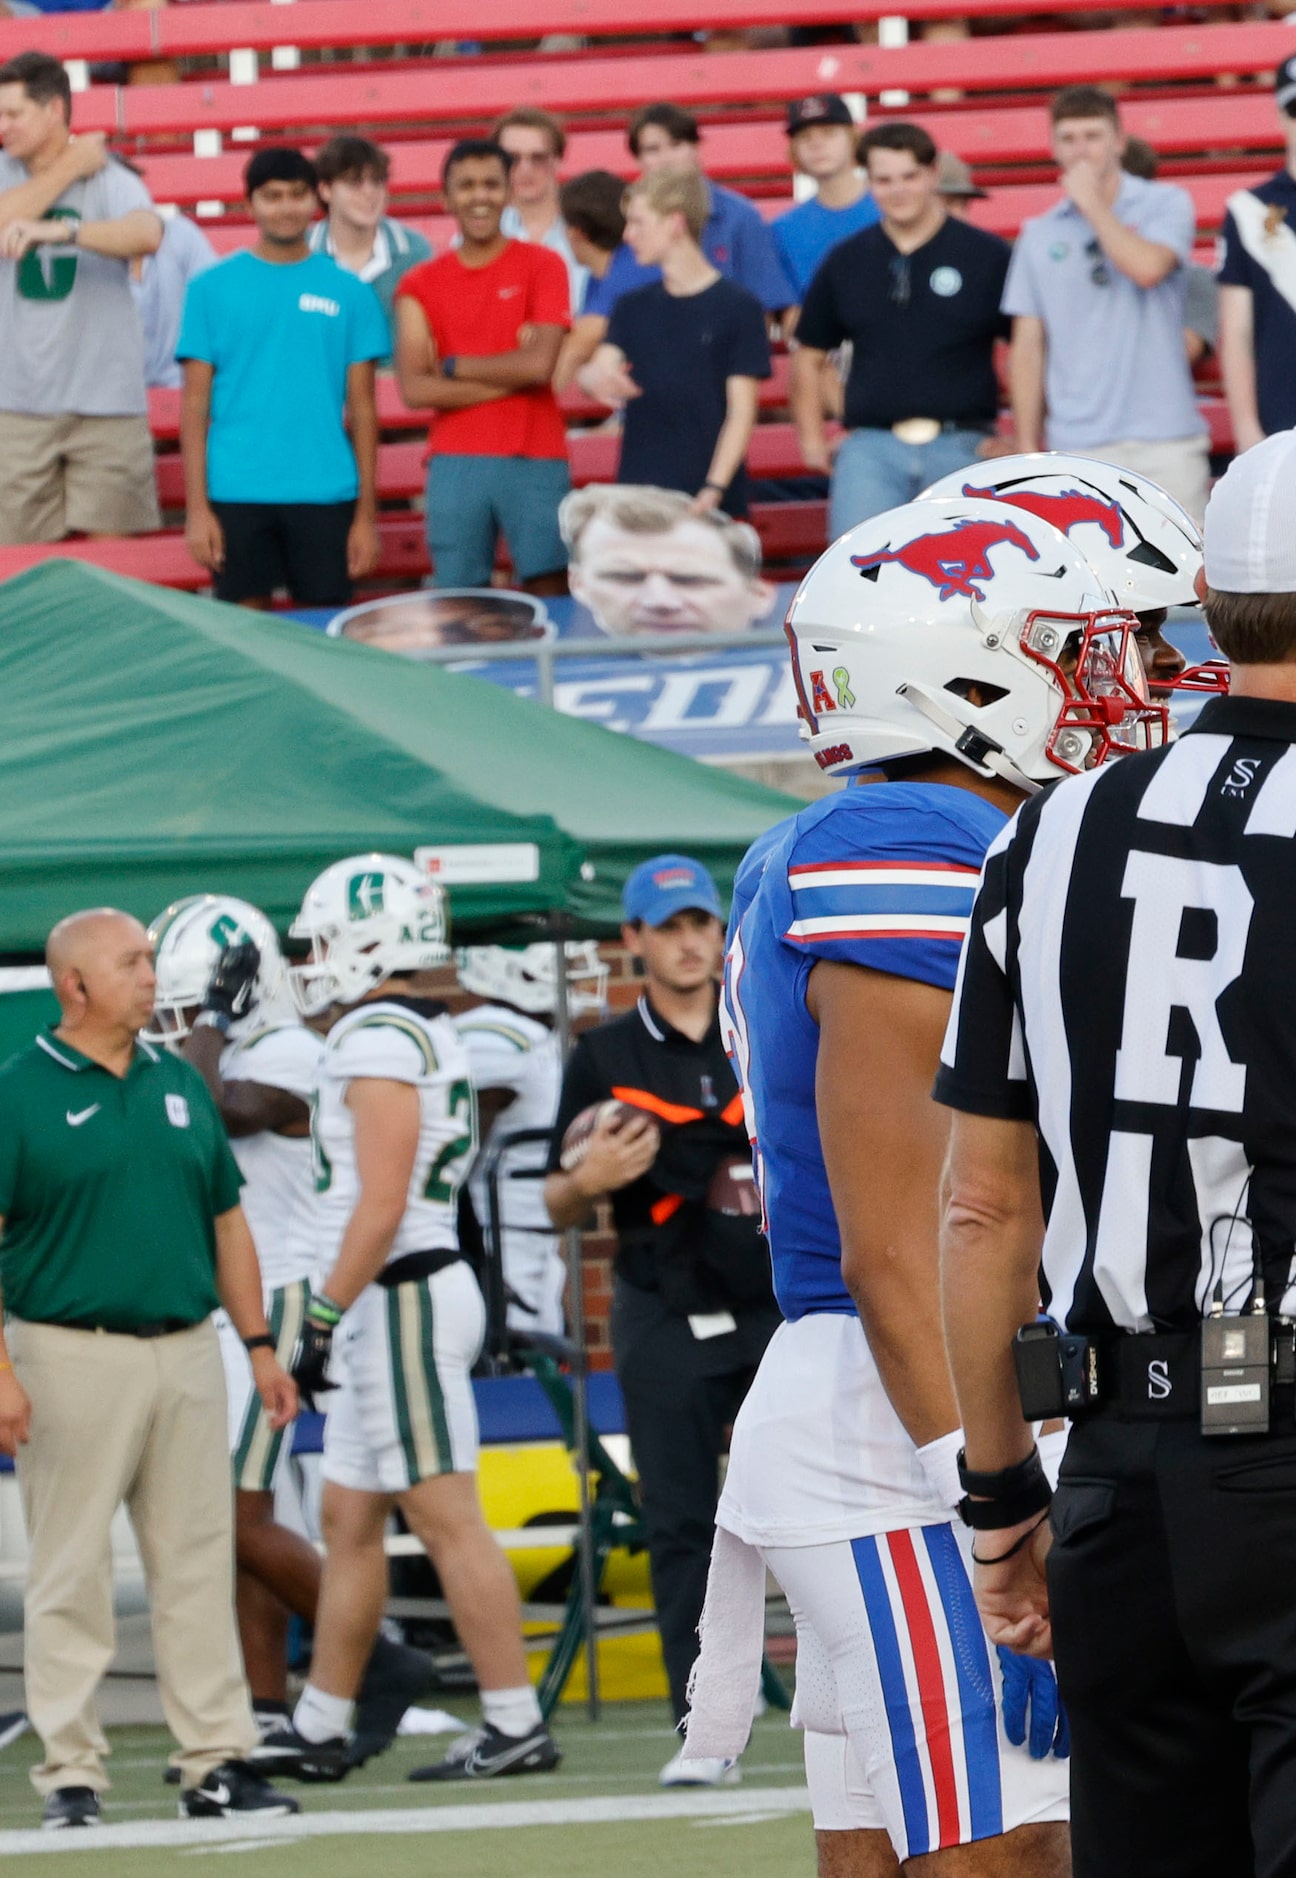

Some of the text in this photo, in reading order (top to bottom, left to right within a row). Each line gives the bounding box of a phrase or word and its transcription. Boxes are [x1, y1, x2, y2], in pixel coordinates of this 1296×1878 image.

[810, 670, 837, 714] A
[1114, 849, 1255, 1114] R
[1148, 1359, 1173, 1399] S
